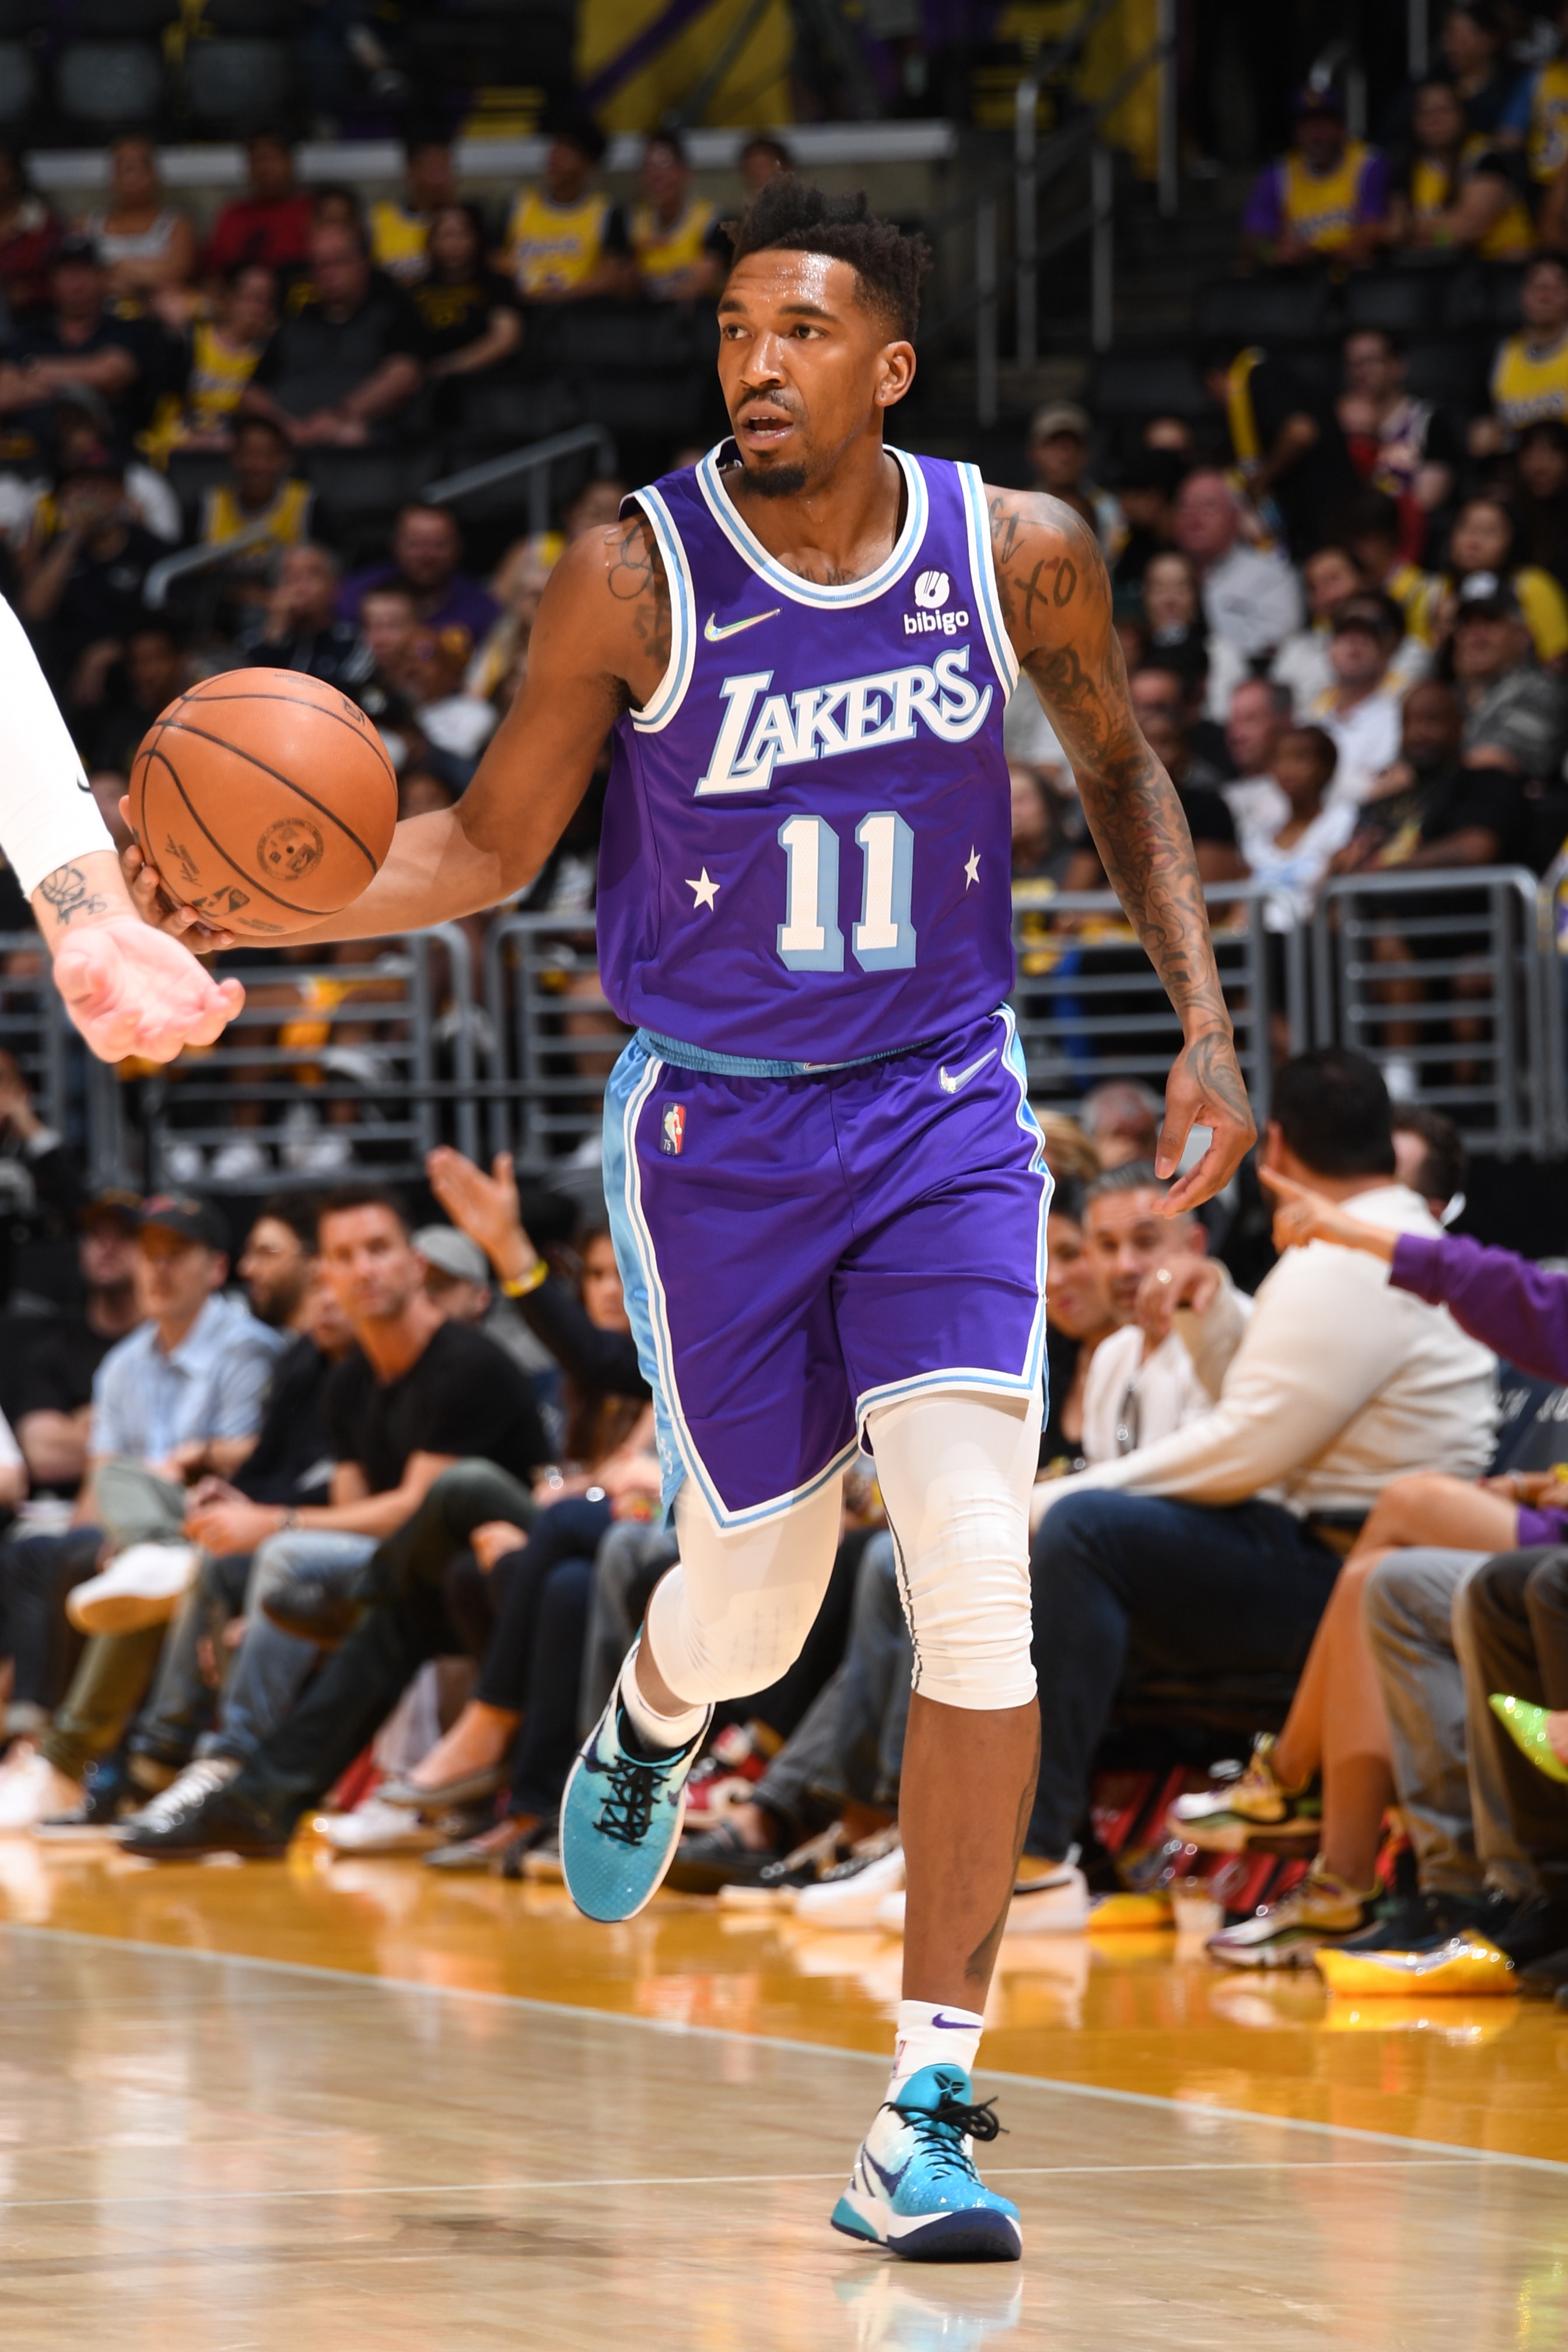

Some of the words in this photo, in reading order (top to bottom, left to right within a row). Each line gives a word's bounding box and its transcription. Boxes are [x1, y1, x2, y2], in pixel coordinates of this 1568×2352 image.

[904, 609, 969, 635] bibigo
[694, 645, 992, 796] LAKERS
[776, 811, 916, 972] 11
[664, 1139, 671, 1151] 75
